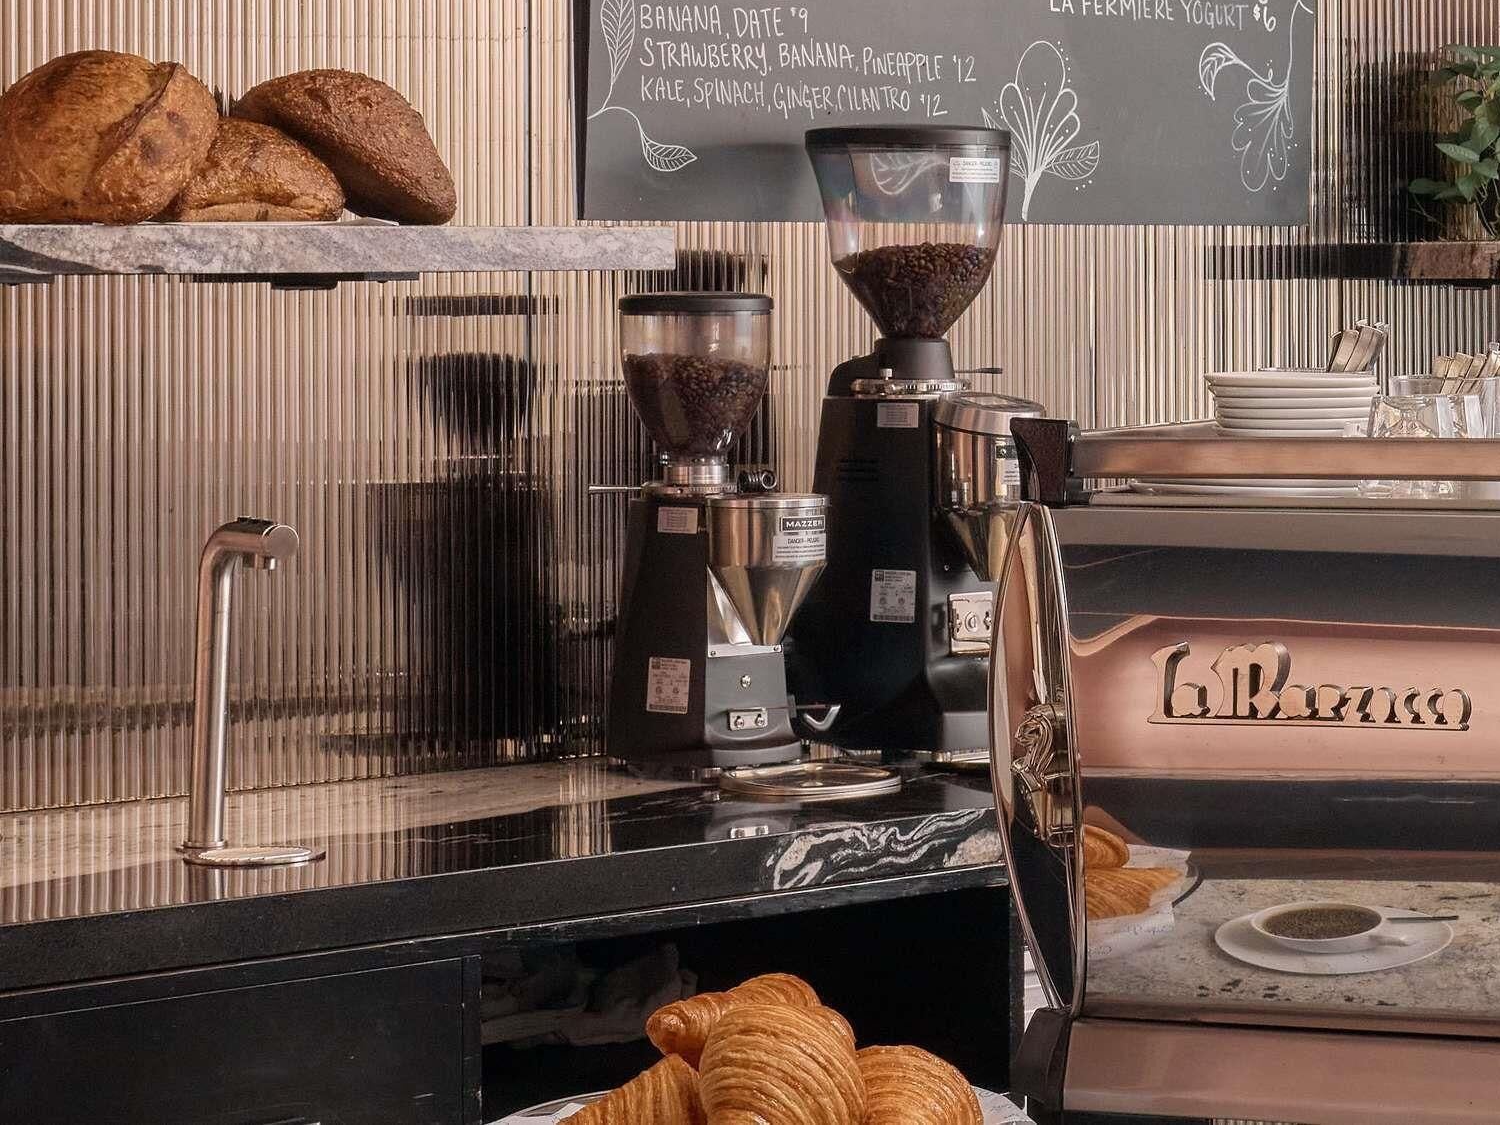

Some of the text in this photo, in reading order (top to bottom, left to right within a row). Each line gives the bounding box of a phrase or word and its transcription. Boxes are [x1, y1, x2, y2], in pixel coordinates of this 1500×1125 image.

[733, 6, 785, 38] DATE
[790, 6, 809, 35] $9
[1251, 3, 1276, 32] $6
[862, 47, 943, 84] PINEAPPLE
[837, 84, 910, 113] CILANTRO
[785, 519, 824, 529] MAZZER
[1148, 641, 1211, 722] La
